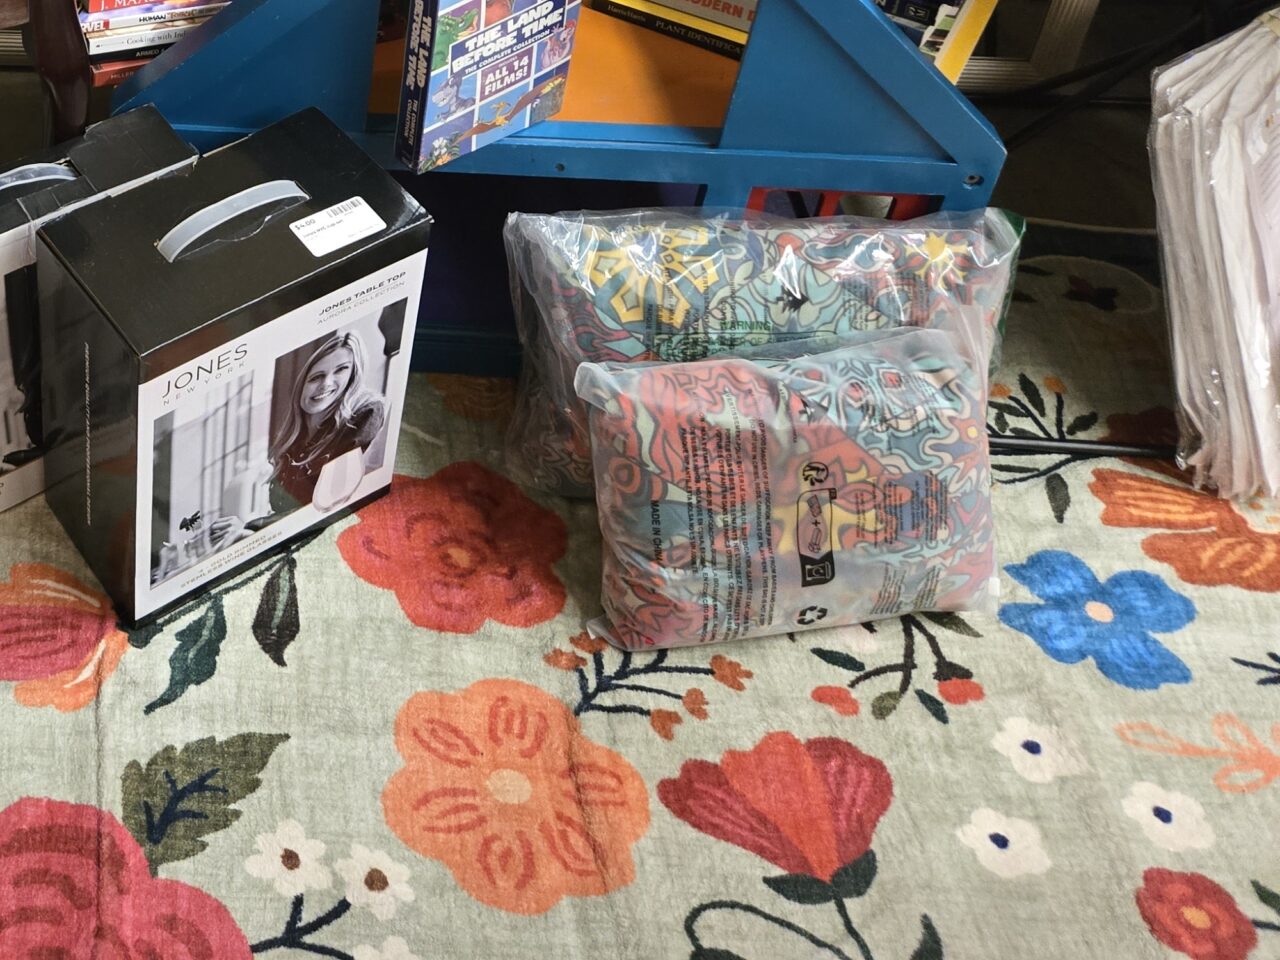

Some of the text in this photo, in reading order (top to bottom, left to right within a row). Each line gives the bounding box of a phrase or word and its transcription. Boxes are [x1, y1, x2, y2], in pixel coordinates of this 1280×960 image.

[100, 0, 109, 10] J.
[139, 14, 166, 23] HUMAN
[126, 37, 155, 45] Cooking
[452, 7, 565, 75] BEFORE TIME
[465, 0, 555, 52] THE LAND
[656, 21, 687, 36] PLANT
[416, 14, 432, 88] THE LAND
[465, 29, 551, 74] THE COMPLETE COLLECTION
[406, 54, 417, 90] TIME
[484, 69, 528, 97] FILMS!
[485, 55, 530, 87] ALL 14
[317, 282, 406, 324] AURORA COLLECTION
[318, 271, 407, 316] JONES TABLE TOP
[720, 320, 773, 331] WARNING
[162, 343, 248, 398] JONES
[163, 361, 245, 406] NEW YORK
[650, 500, 661, 526] MADE
[652, 527, 661, 535] IN
